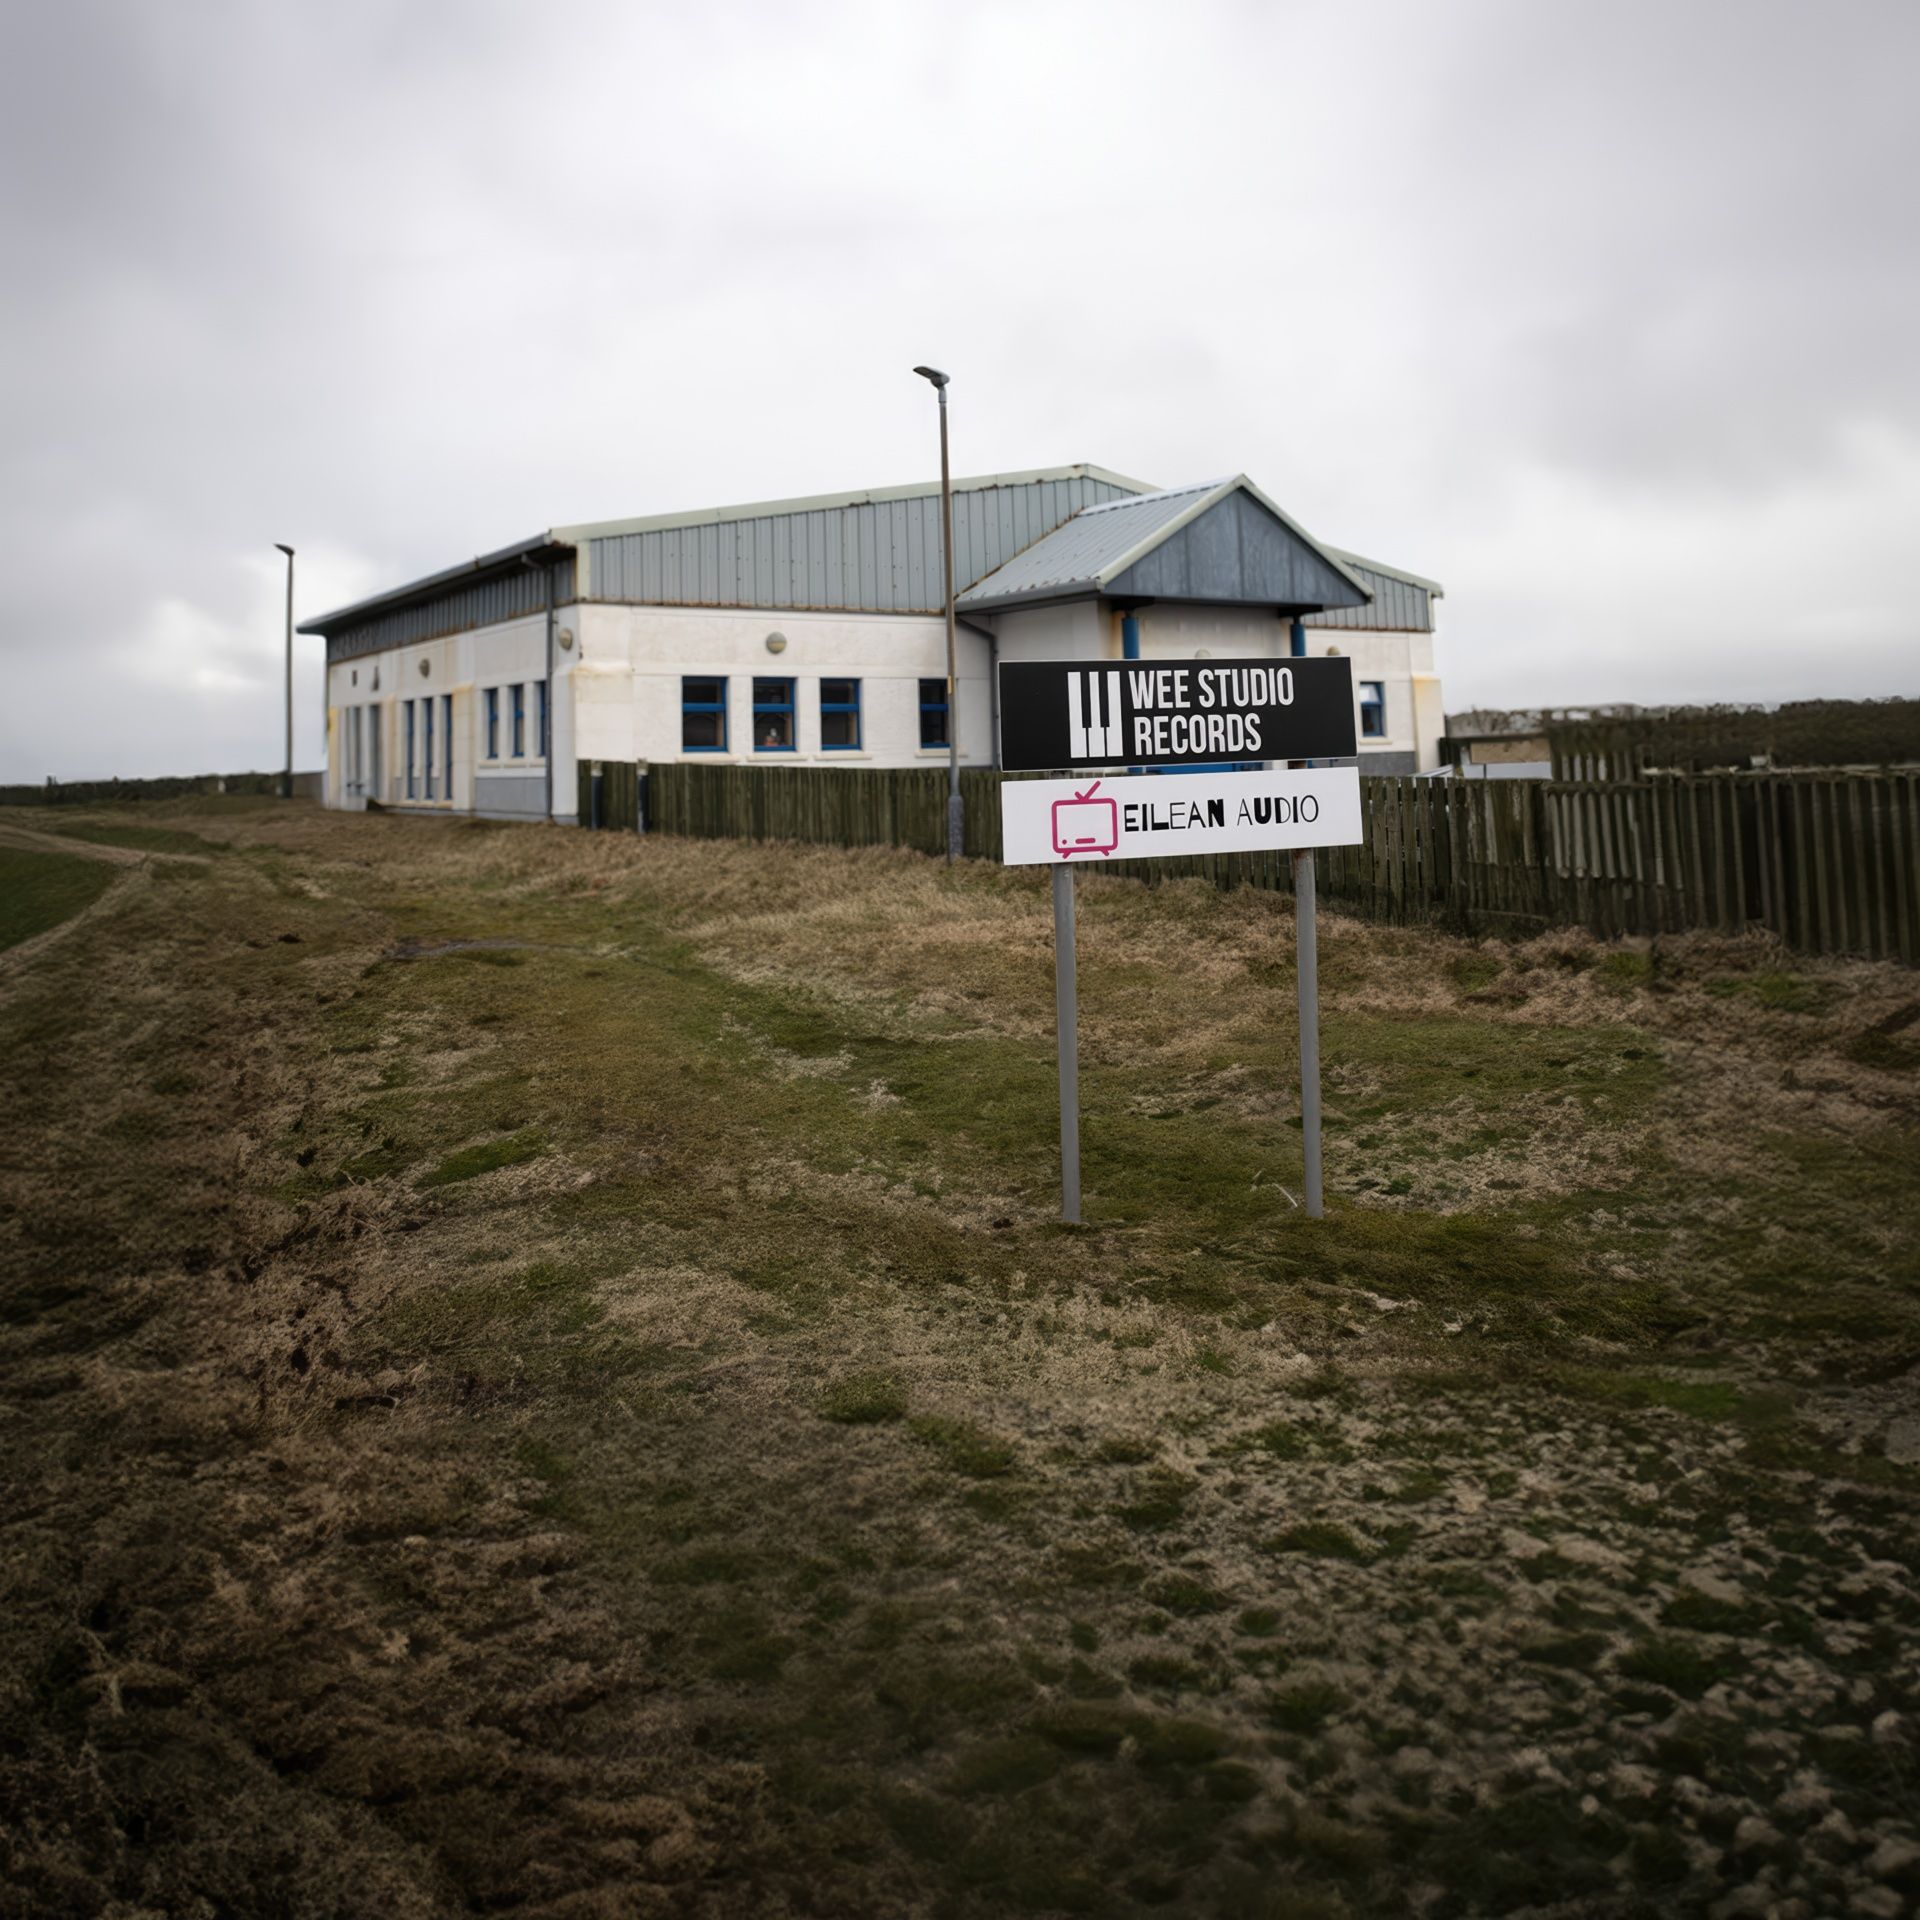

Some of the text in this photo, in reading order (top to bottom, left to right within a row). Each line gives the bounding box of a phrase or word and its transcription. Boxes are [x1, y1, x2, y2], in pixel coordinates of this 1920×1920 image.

[1128, 667, 1294, 710] WEE STUDIO
[1133, 713, 1262, 756] RECORDS
[1123, 795, 1319, 832] EILEAN AUDIO
